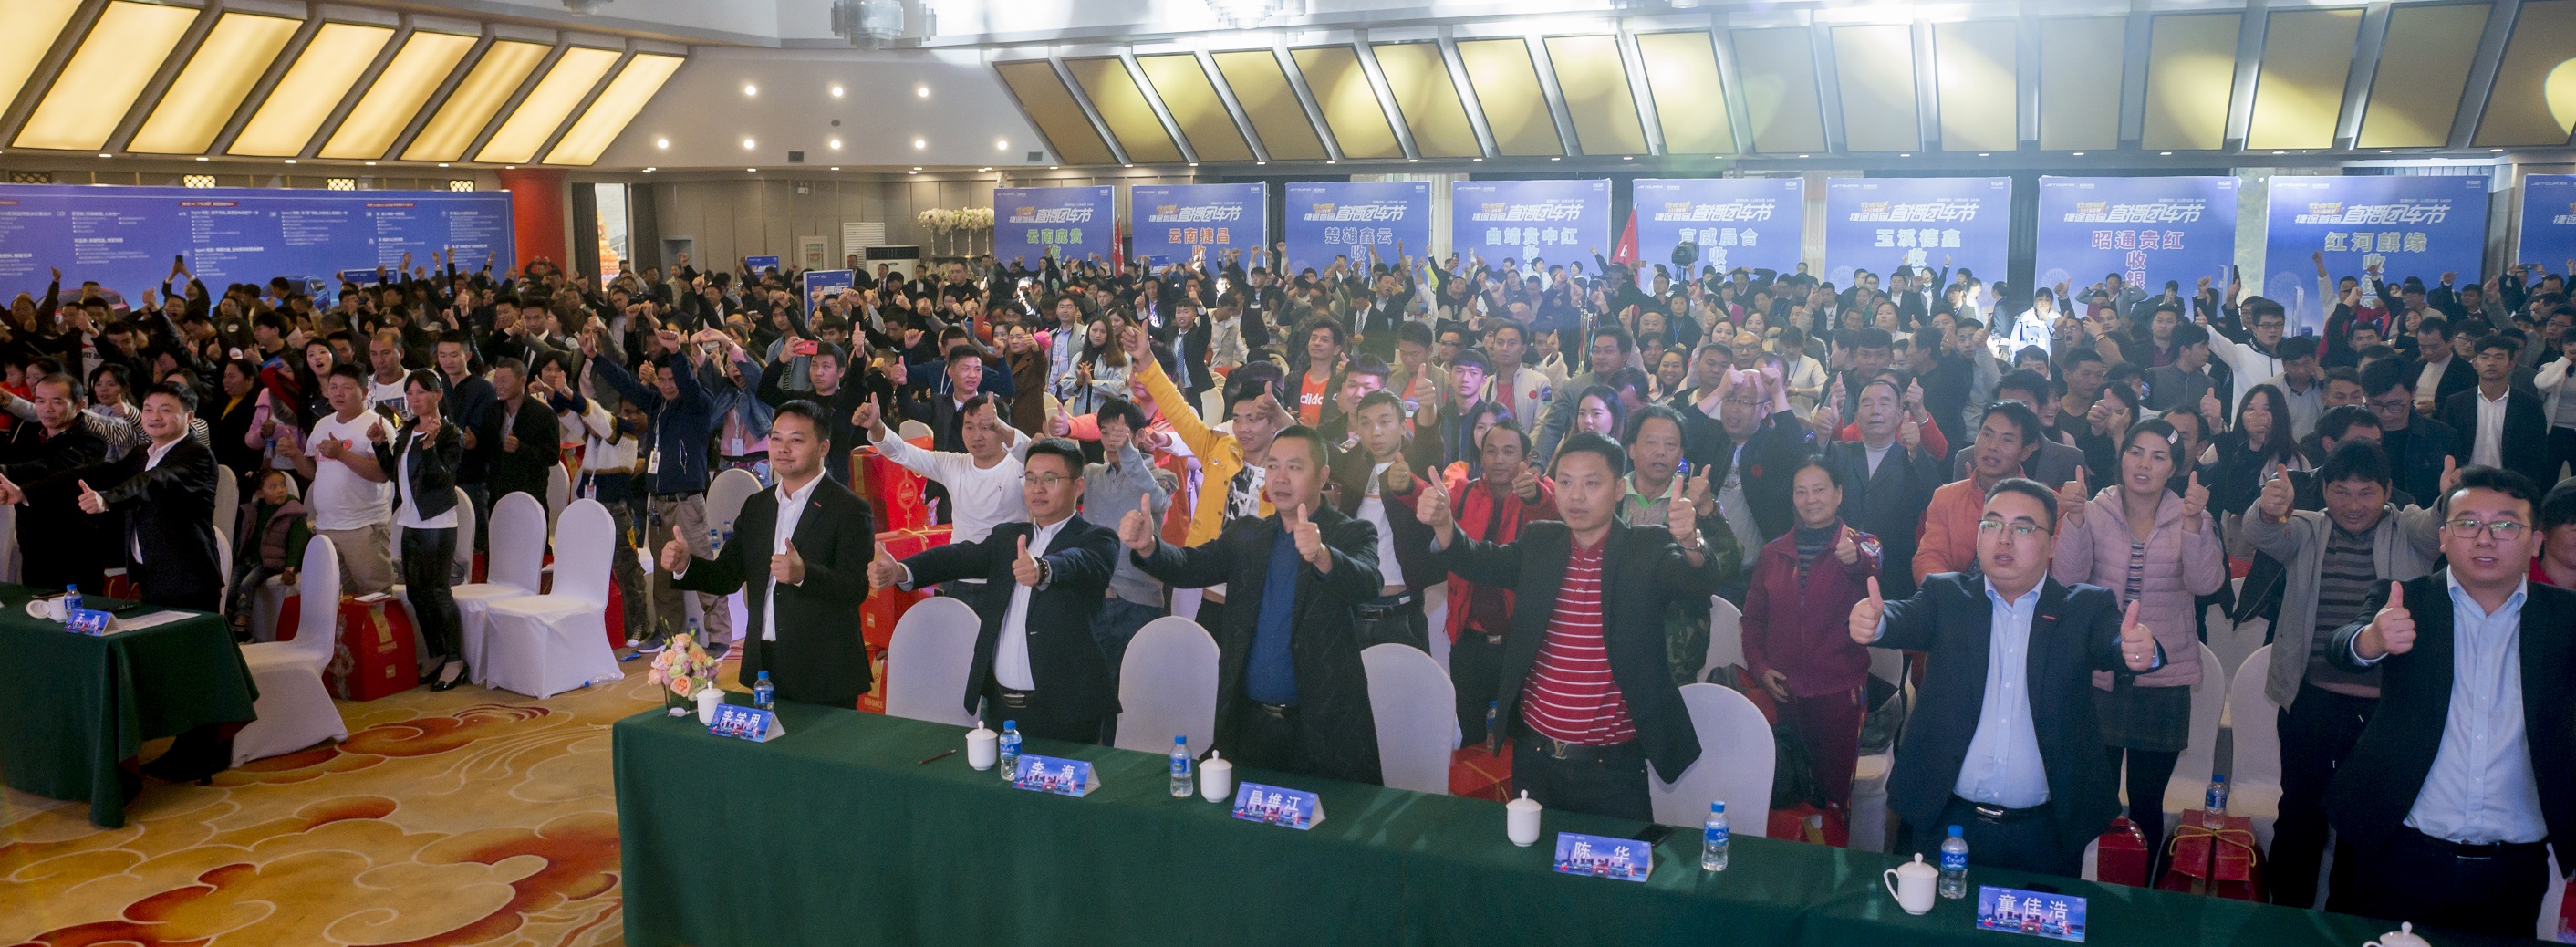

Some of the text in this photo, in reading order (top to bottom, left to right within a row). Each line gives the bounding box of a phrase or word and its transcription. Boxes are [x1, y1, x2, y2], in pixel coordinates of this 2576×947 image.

[1169, 227, 1231, 244] 云南捷昌
[1325, 227, 1393, 244] 楚雄鑫云
[1486, 227, 1578, 245] 曲靖贵中红
[1875, 228, 1961, 247] 玉溪德鑫
[2092, 230, 2184, 250] 昭通贵红
[2324, 231, 2427, 253] 红河麒缘
[722, 710, 761, 726] 李学用
[1998, 894, 2068, 920] 童佳浩
